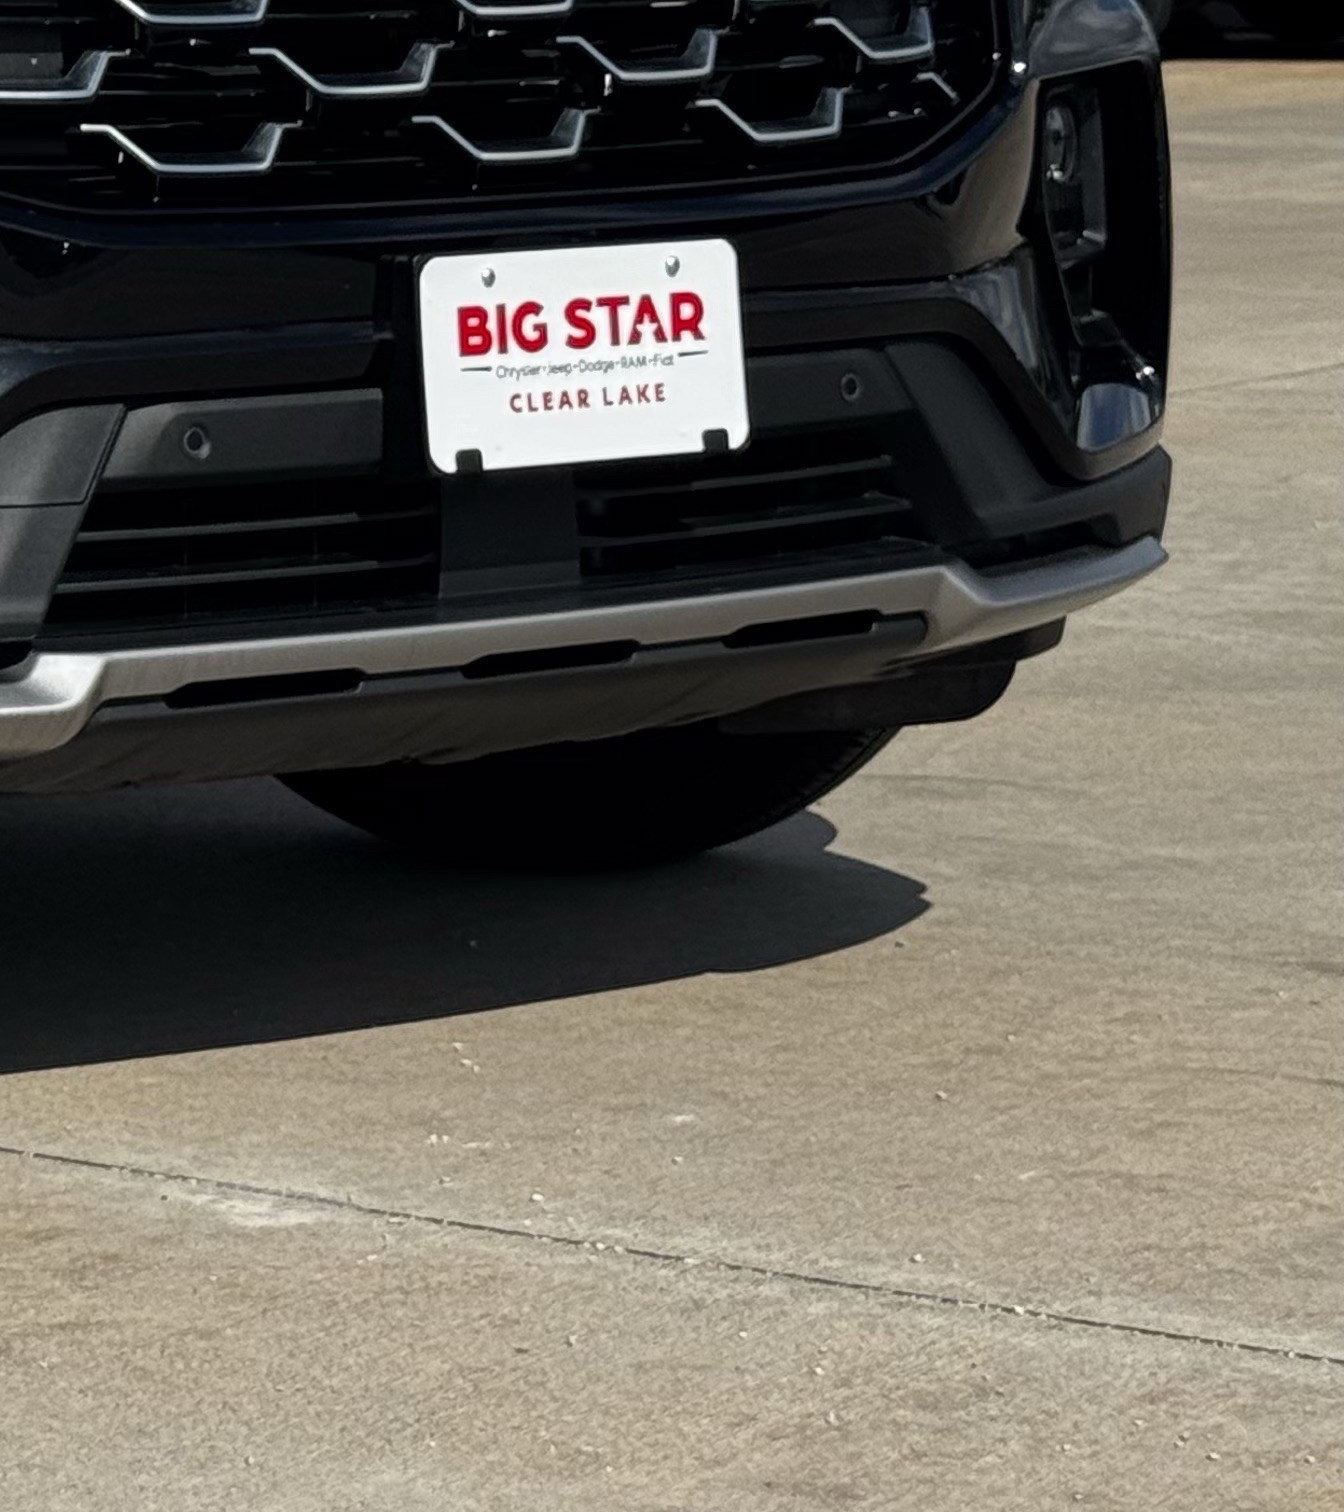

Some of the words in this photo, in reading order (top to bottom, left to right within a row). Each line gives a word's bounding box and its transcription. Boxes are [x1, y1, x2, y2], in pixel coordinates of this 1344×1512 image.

[457, 300, 548, 356] BIG
[564, 292, 705, 349] STAR
[509, 389, 590, 413] CLEAR
[602, 383, 666, 406] LAKE
